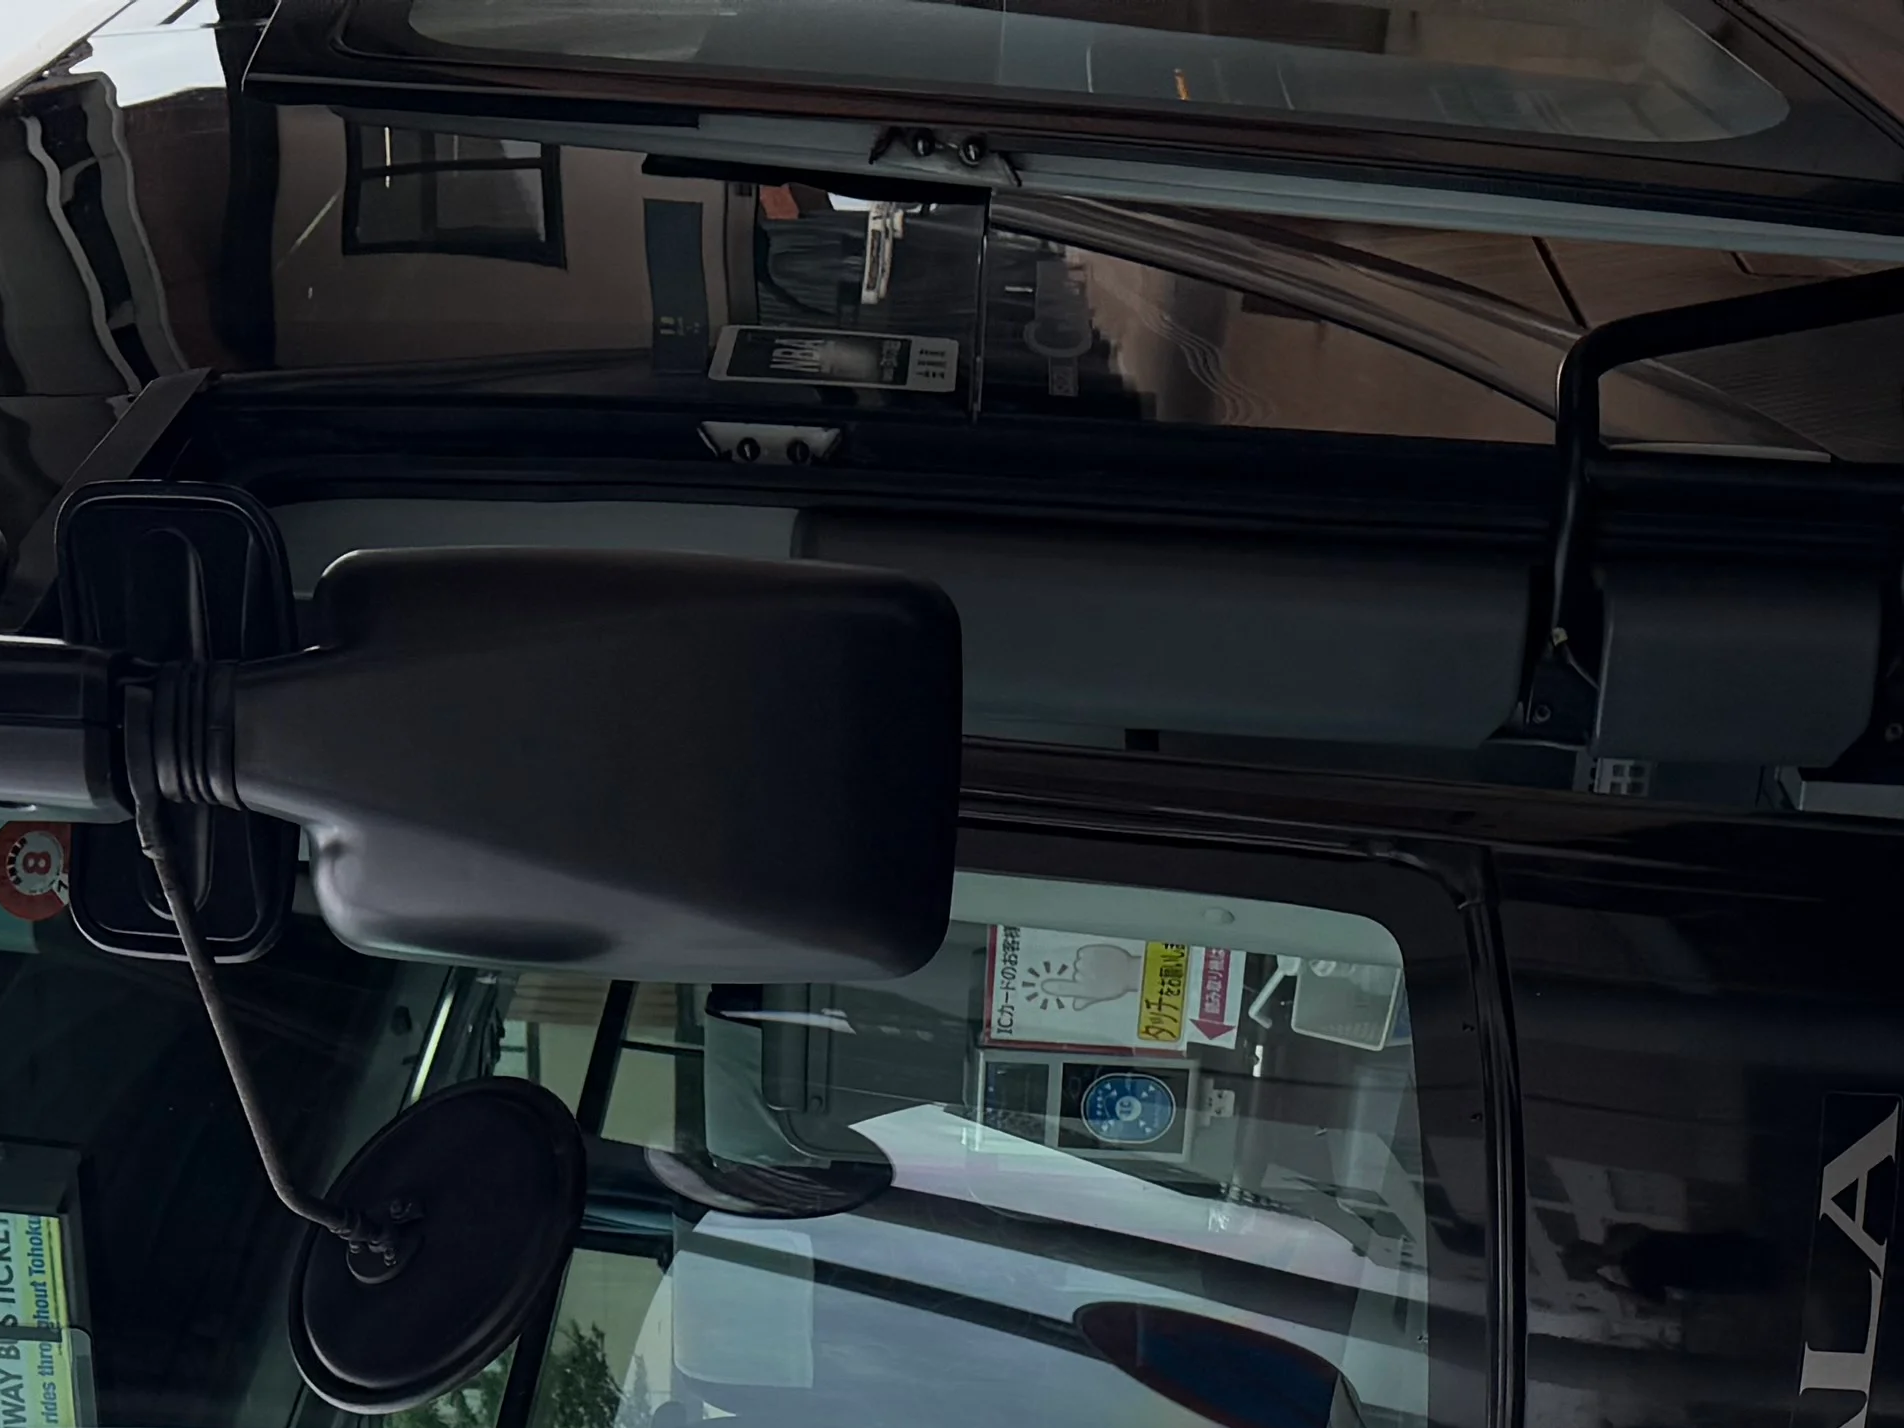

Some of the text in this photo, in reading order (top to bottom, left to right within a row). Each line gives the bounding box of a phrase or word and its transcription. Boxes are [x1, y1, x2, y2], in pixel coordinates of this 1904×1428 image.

[22, 851, 51, 875] 8
[26, 1215, 45, 1276] Tohoku
[39, 1382, 59, 1424] rides
